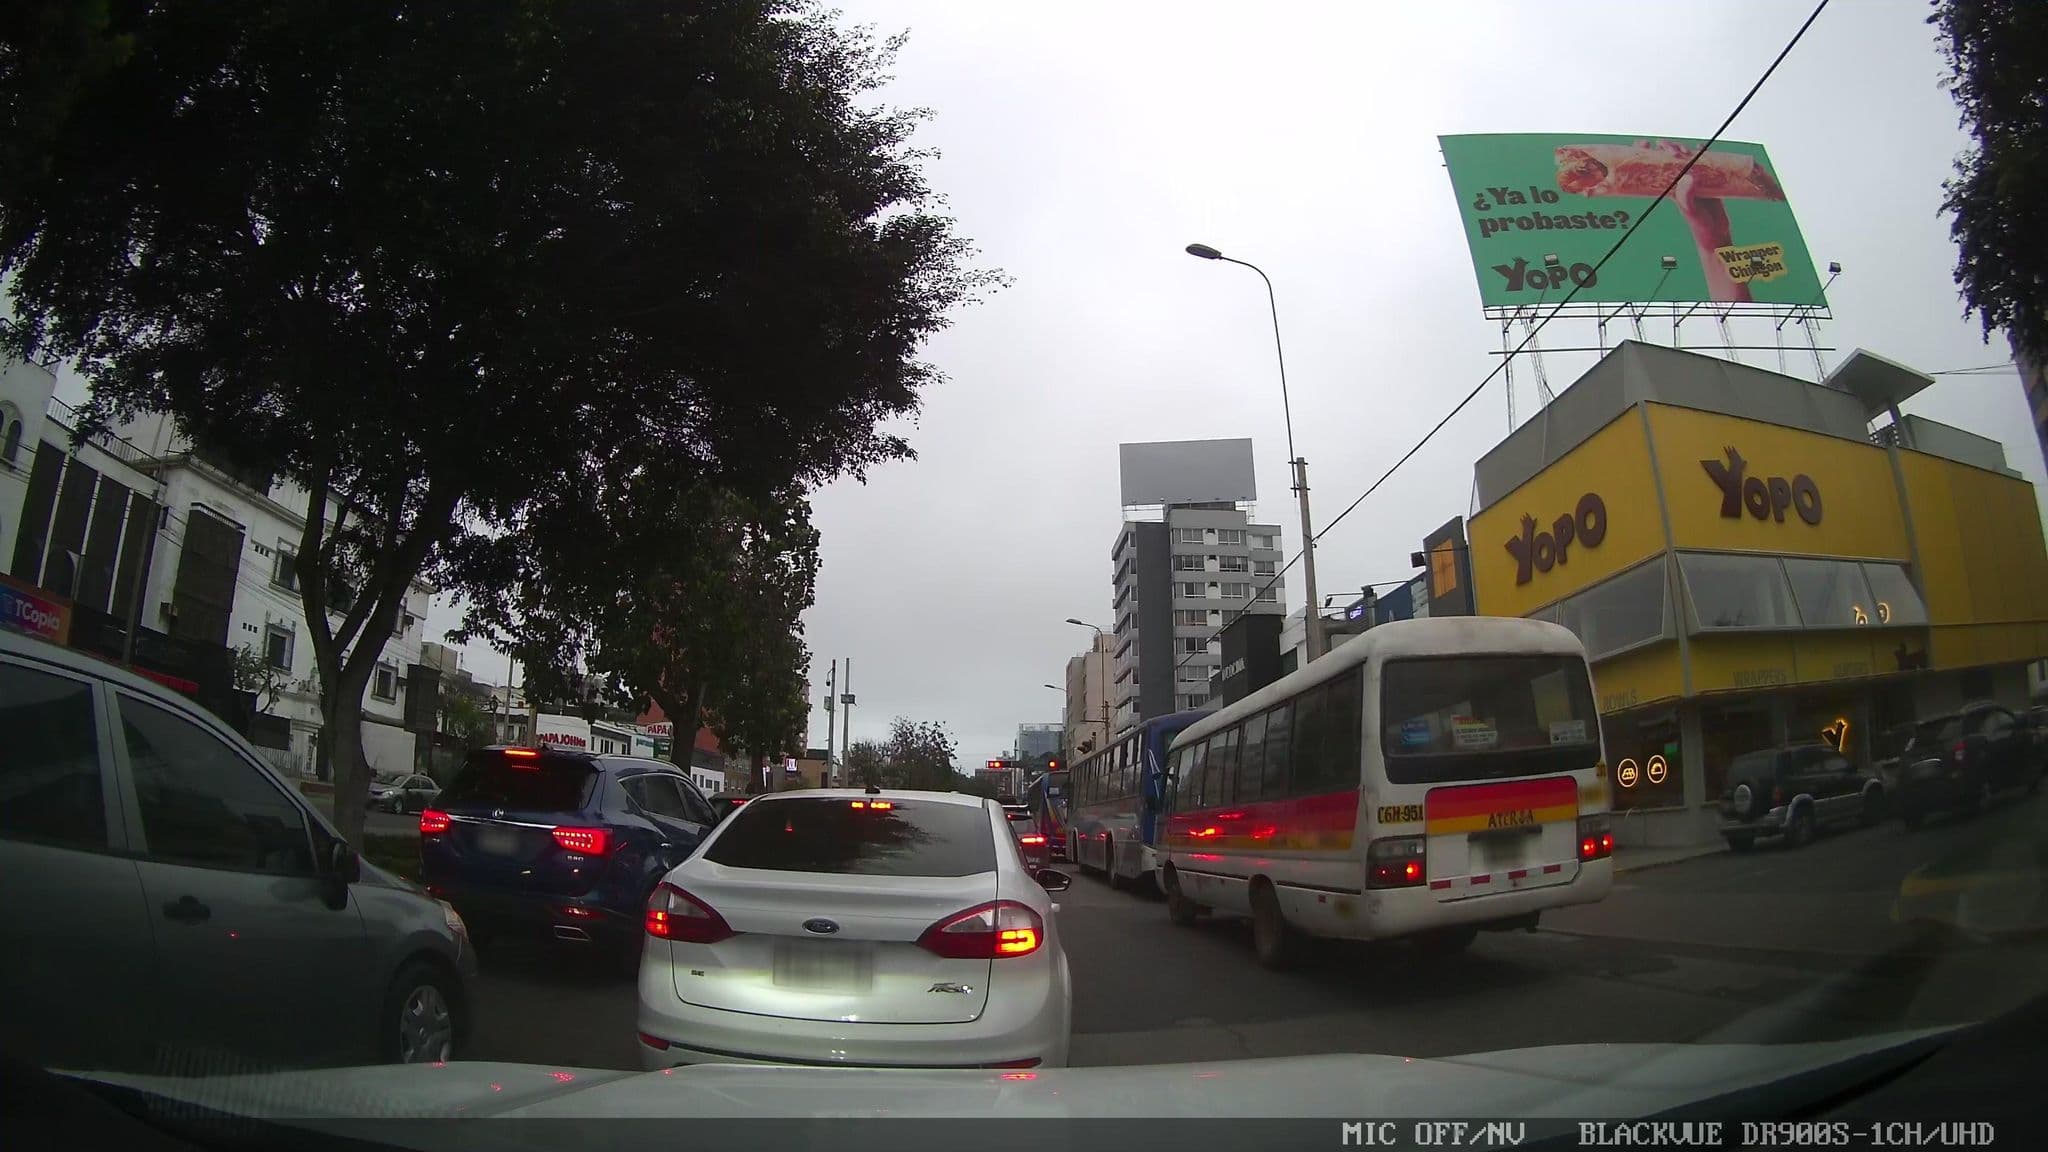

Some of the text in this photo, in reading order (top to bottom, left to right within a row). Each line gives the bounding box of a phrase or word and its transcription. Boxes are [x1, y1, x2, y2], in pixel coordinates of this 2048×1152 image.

[1473, 186, 1559, 211] ¿Ya lo
[1478, 210, 1630, 238] probaste?
[1377, 803, 1424, 824] C6H-951
